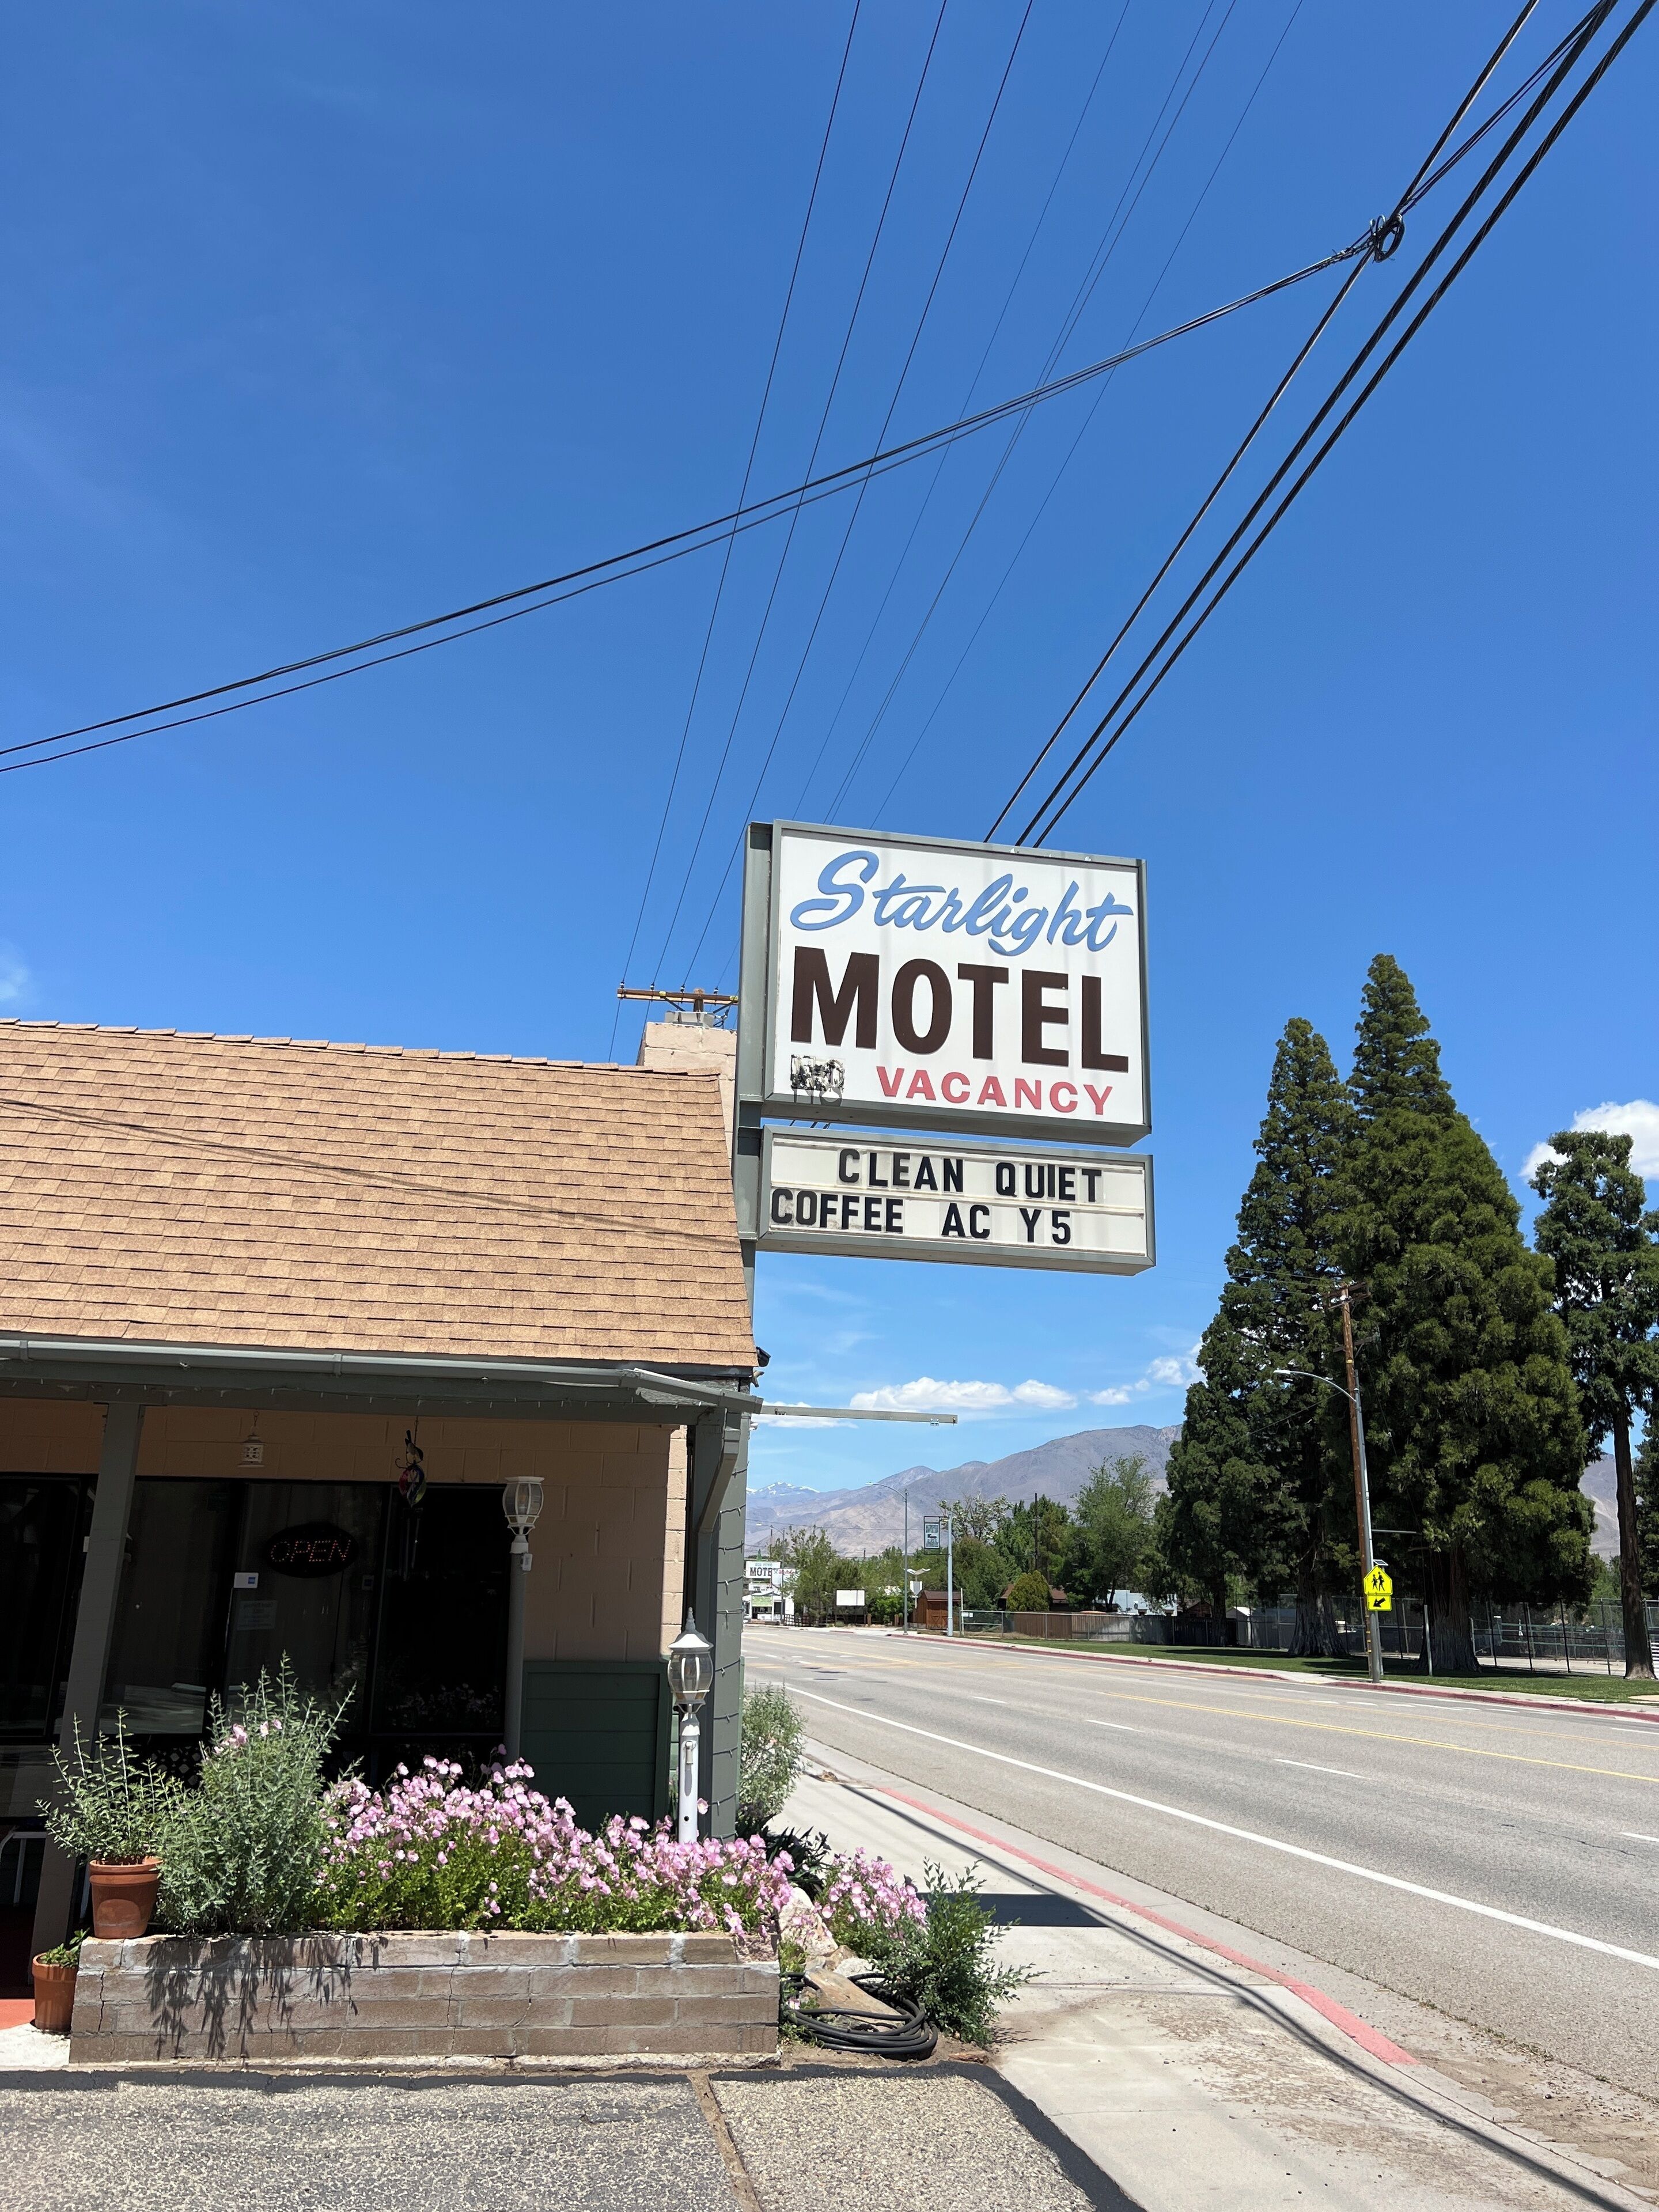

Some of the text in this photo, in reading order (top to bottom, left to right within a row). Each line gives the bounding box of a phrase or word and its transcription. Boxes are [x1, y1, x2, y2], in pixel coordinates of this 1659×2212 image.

[790, 851, 1134, 956] Starlight
[791, 946, 1128, 1072] MOTEL
[877, 1066, 1113, 1115] VACANCY
[839, 1149, 1103, 1203] CLEAN QUIET
[771, 1188, 904, 1233] COFFEE
[941, 1202, 991, 1239] AC
[271, 1539, 351, 1562] OPEN
[750, 1567, 775, 1577] MOTE
